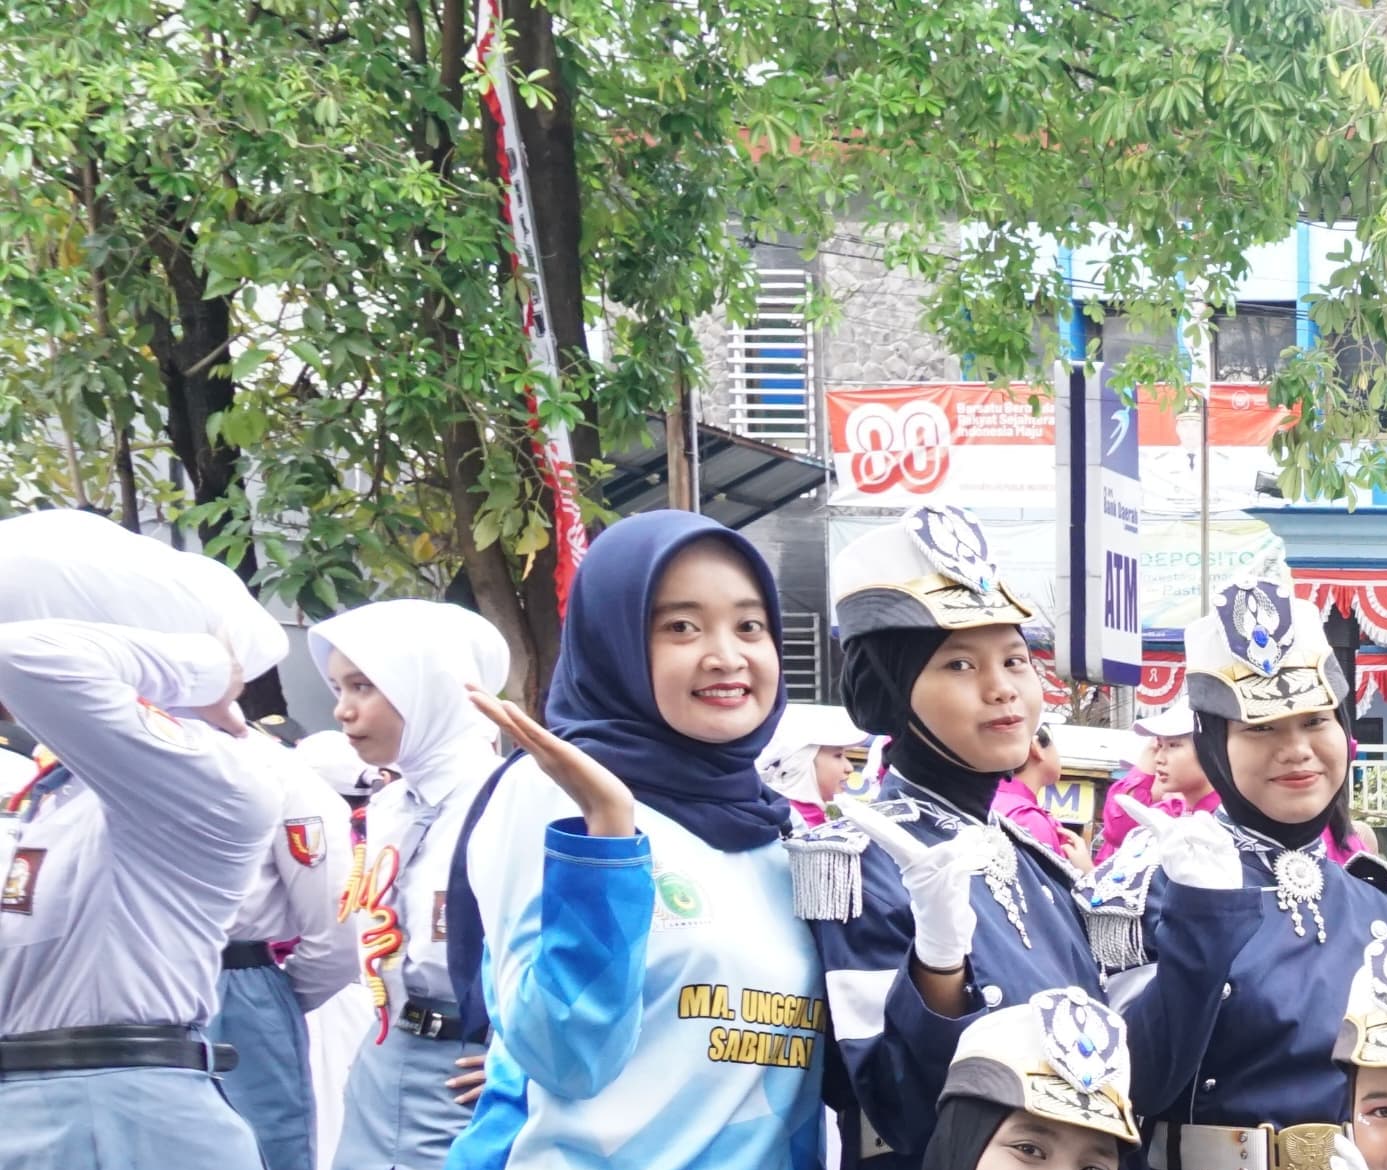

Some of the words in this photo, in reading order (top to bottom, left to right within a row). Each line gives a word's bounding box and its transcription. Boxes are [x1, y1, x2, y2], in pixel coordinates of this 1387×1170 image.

[846, 401, 950, 494] 80
[1139, 551, 1255, 567] DEPOSITO
[1104, 549, 1138, 635] ATM
[678, 983, 736, 1020] MA.
